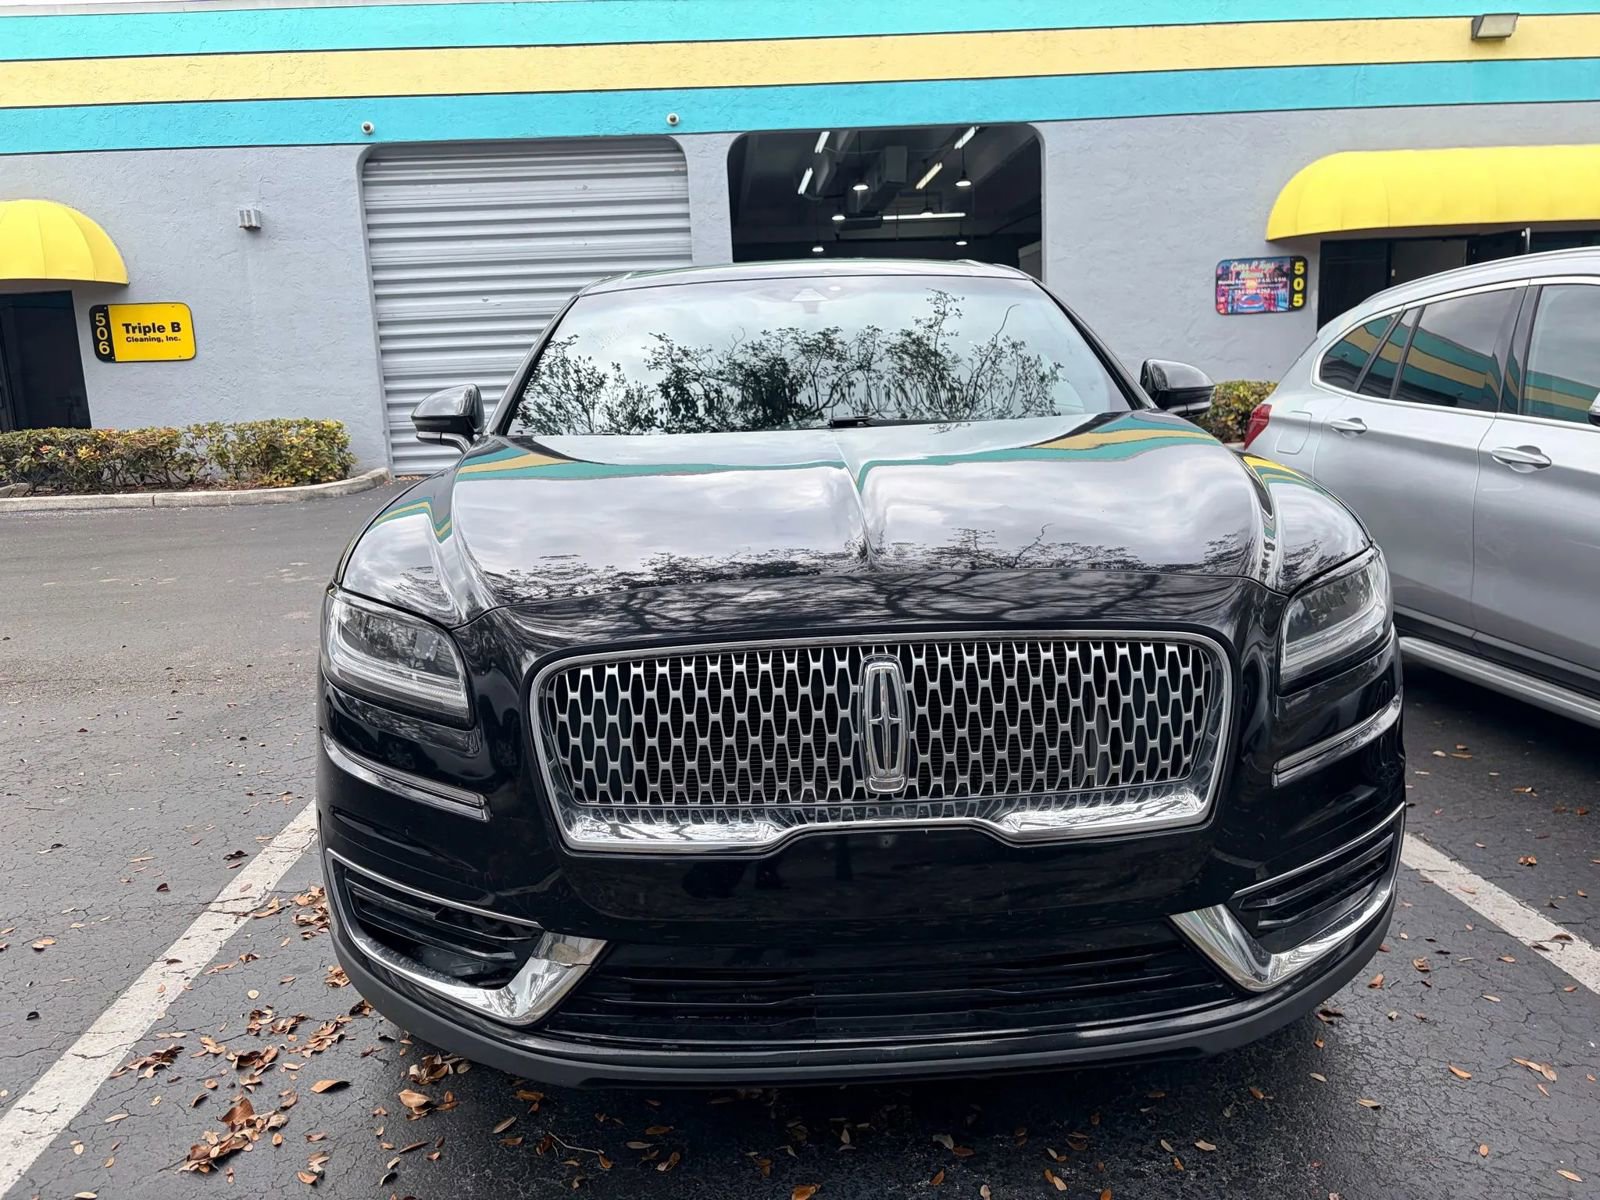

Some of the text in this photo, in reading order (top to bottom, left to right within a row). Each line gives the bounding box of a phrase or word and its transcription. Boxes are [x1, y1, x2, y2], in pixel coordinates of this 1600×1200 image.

[1293, 262, 1305, 307] 505
[95, 313, 110, 354] 506
[122, 322, 182, 336] Triple B
